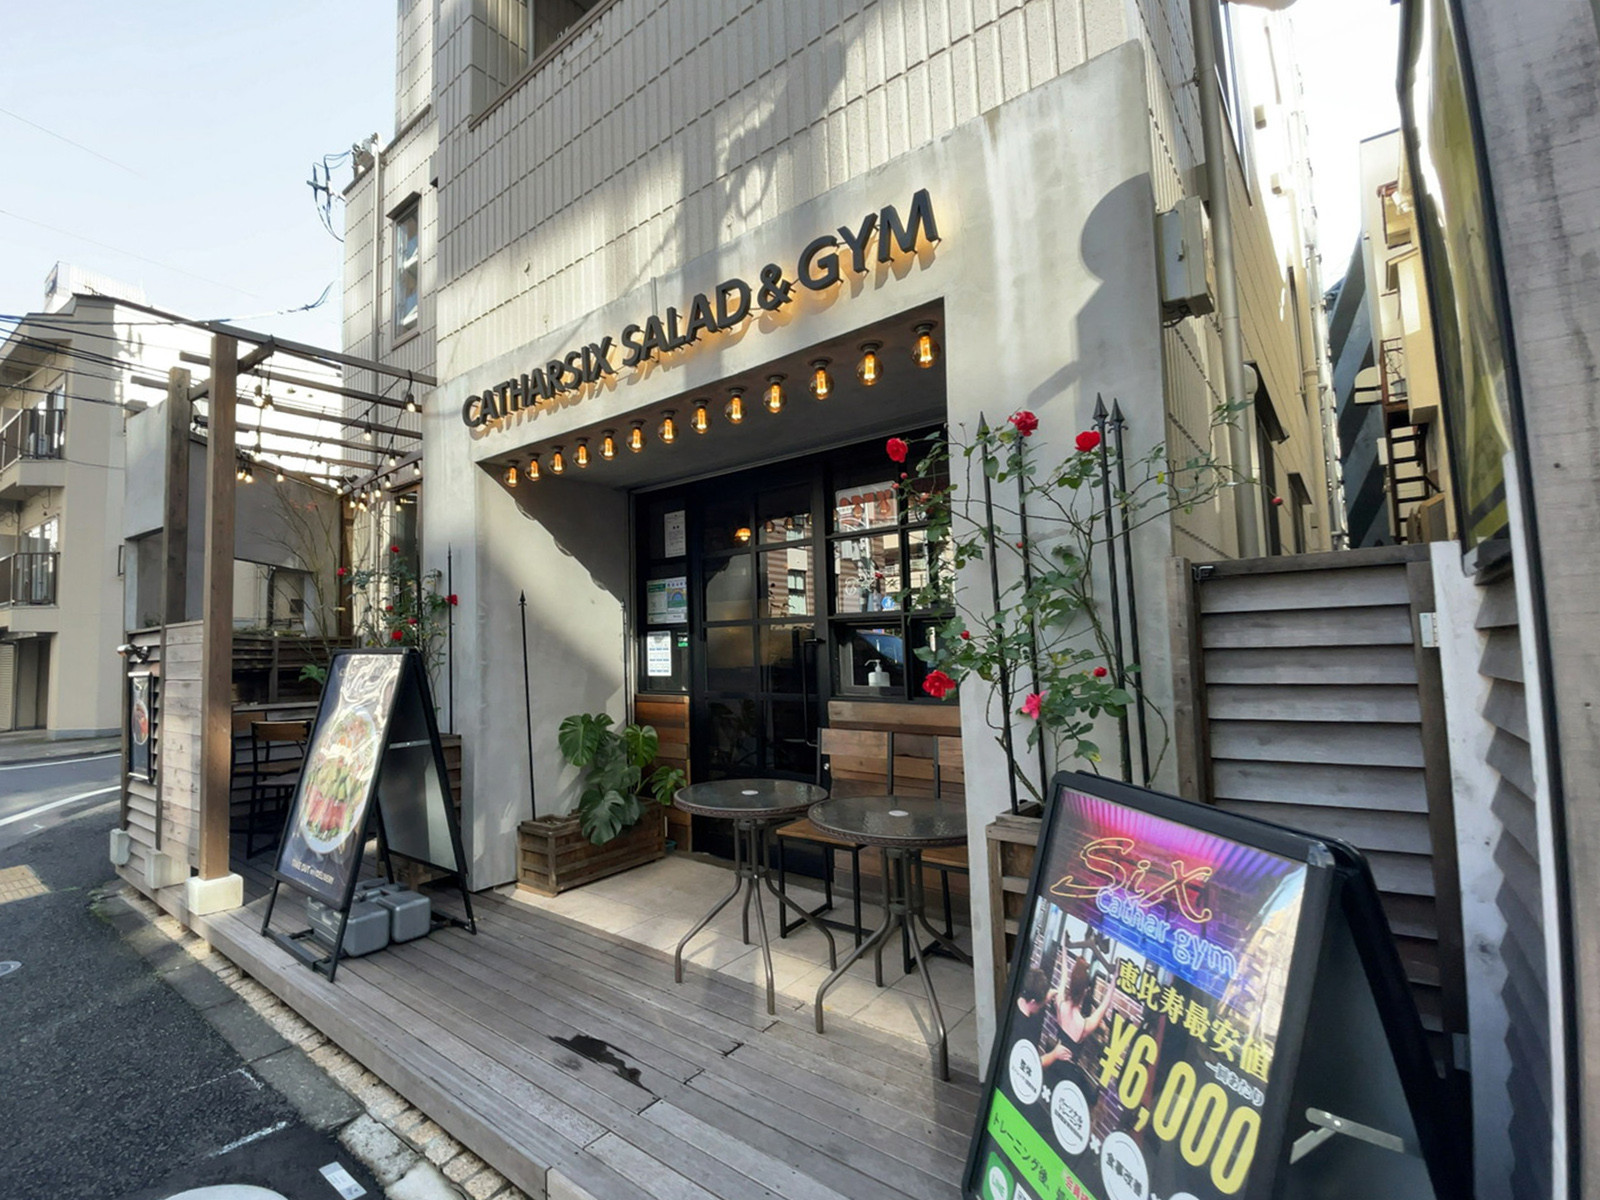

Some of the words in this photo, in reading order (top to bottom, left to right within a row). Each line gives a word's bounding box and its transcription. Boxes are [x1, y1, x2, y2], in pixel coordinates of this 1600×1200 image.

[462, 336, 616, 428] CATHARSIX
[621, 278, 752, 367] SALAD
[798, 188, 940, 291] GYM
[1095, 885, 1171, 943] Cathar
[1172, 928, 1238, 980] gym
[1116, 959, 1274, 1083] 恵比寿最安値
[1099, 1012, 1262, 1195] ¥6,000
[1204, 1060, 1265, 1107] 一回あたり
